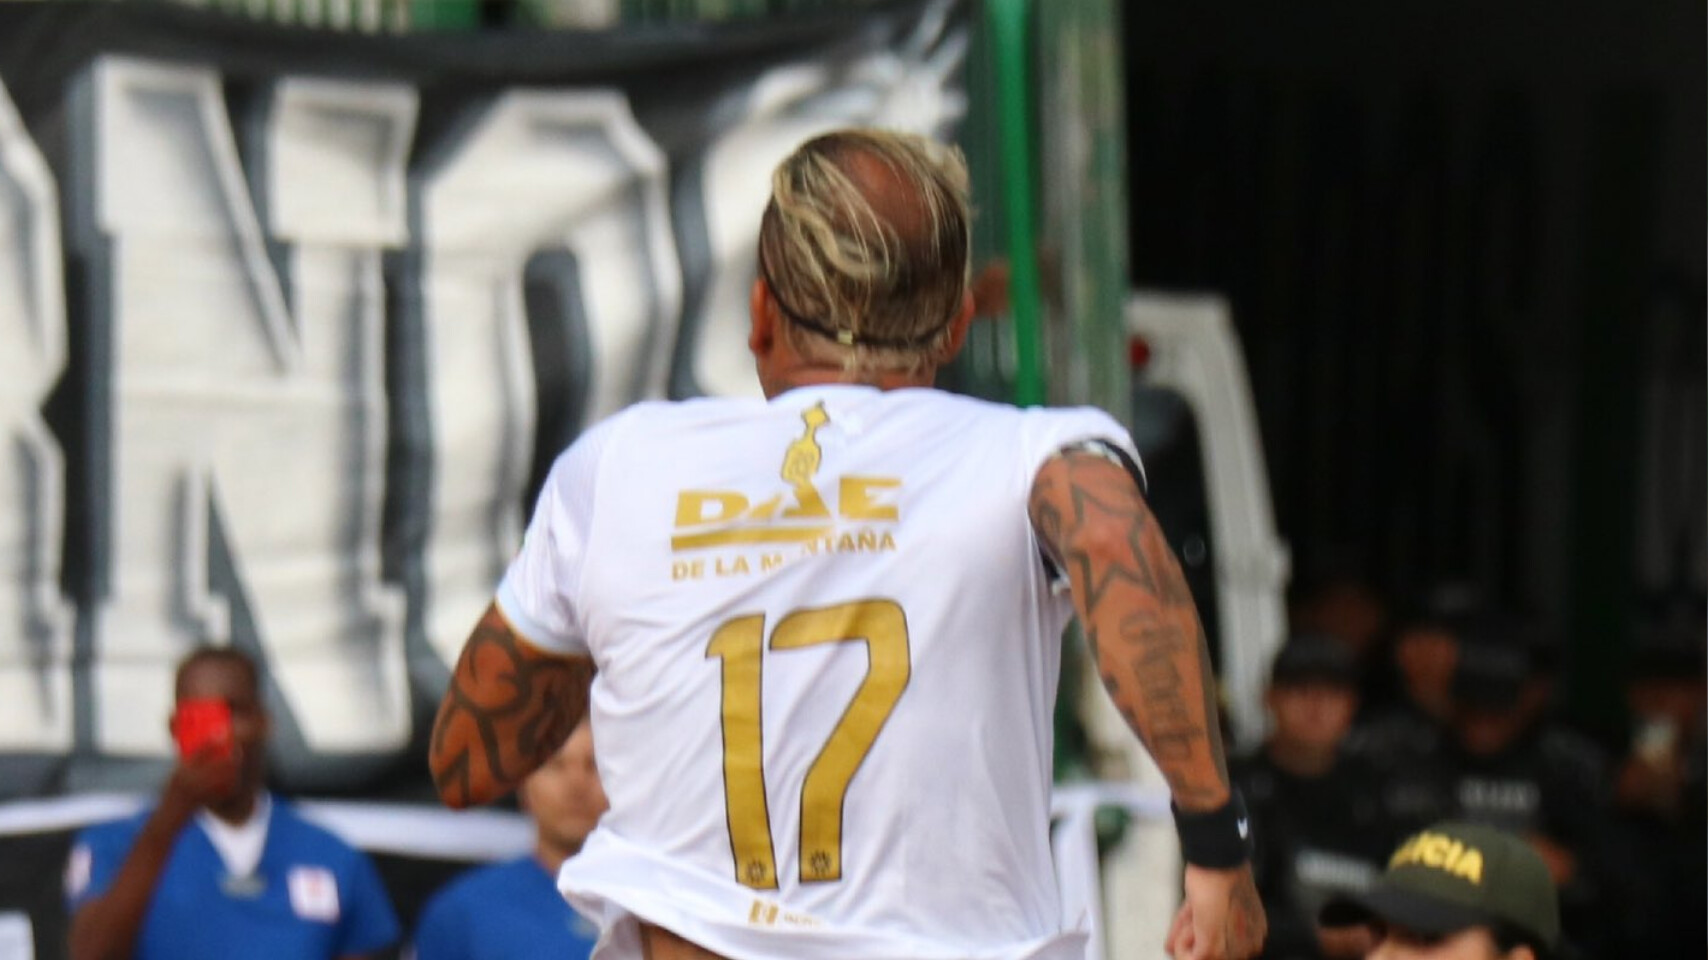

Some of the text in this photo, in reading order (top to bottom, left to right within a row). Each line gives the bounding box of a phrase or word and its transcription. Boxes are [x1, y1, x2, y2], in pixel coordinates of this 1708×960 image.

[671, 558, 705, 581] DE
[714, 554, 750, 577] LA
[705, 596, 911, 891] 17
